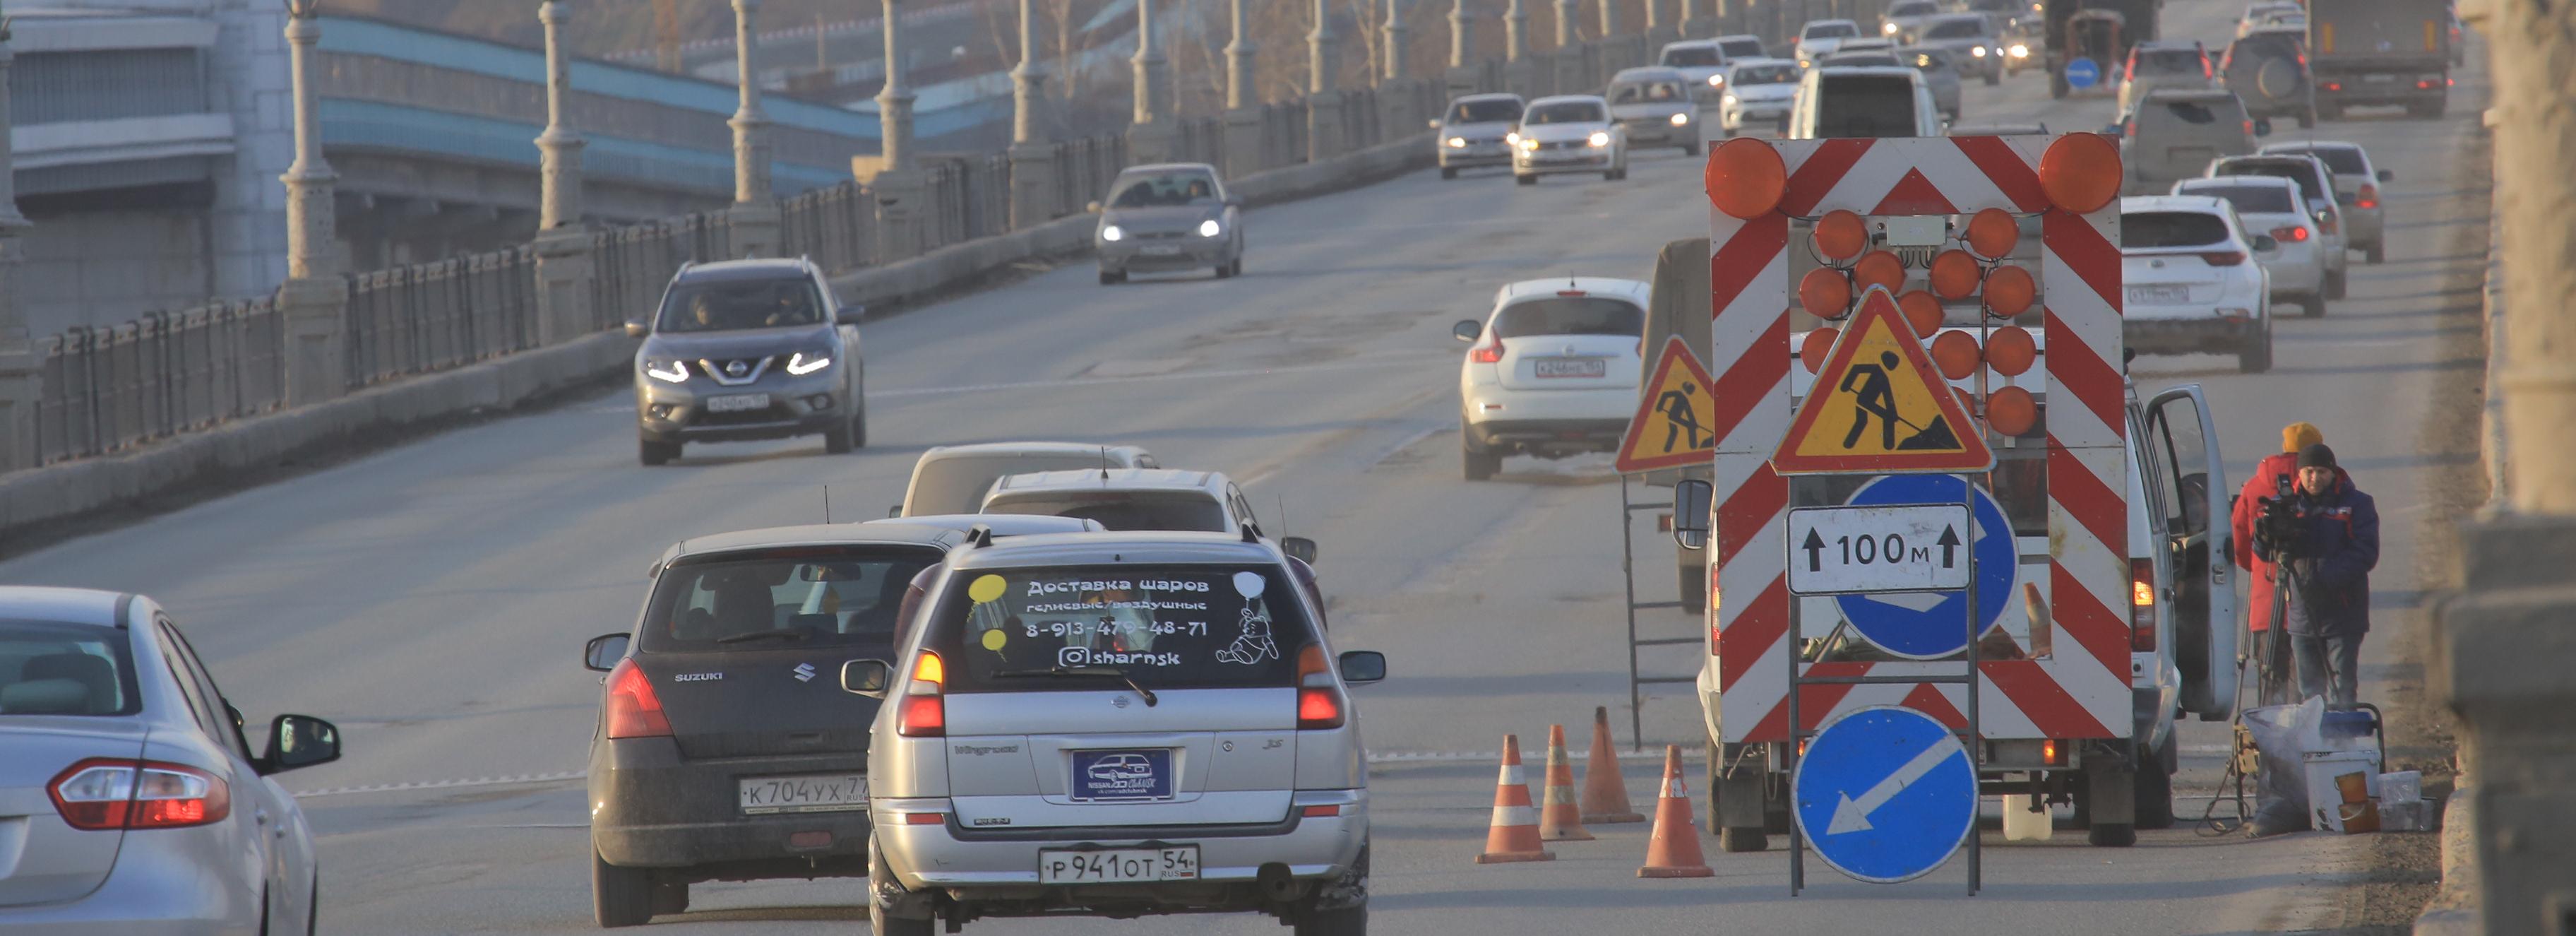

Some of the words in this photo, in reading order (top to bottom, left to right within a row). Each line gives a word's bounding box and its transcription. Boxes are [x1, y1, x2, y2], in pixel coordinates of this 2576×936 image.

[1837, 533, 1905, 564] 100
[1027, 580, 1131, 597] Доставка
[1139, 579, 1210, 593] шаров
[1026, 621, 1207, 637] 8-913-479-48-71
[1093, 651, 1181, 666] sharnsk
[674, 672, 723, 682] SUZUKI
[750, 780, 840, 803] К704УХ
[1053, 854, 1154, 879] Р941ОТ
[1163, 850, 1188, 868] 54
